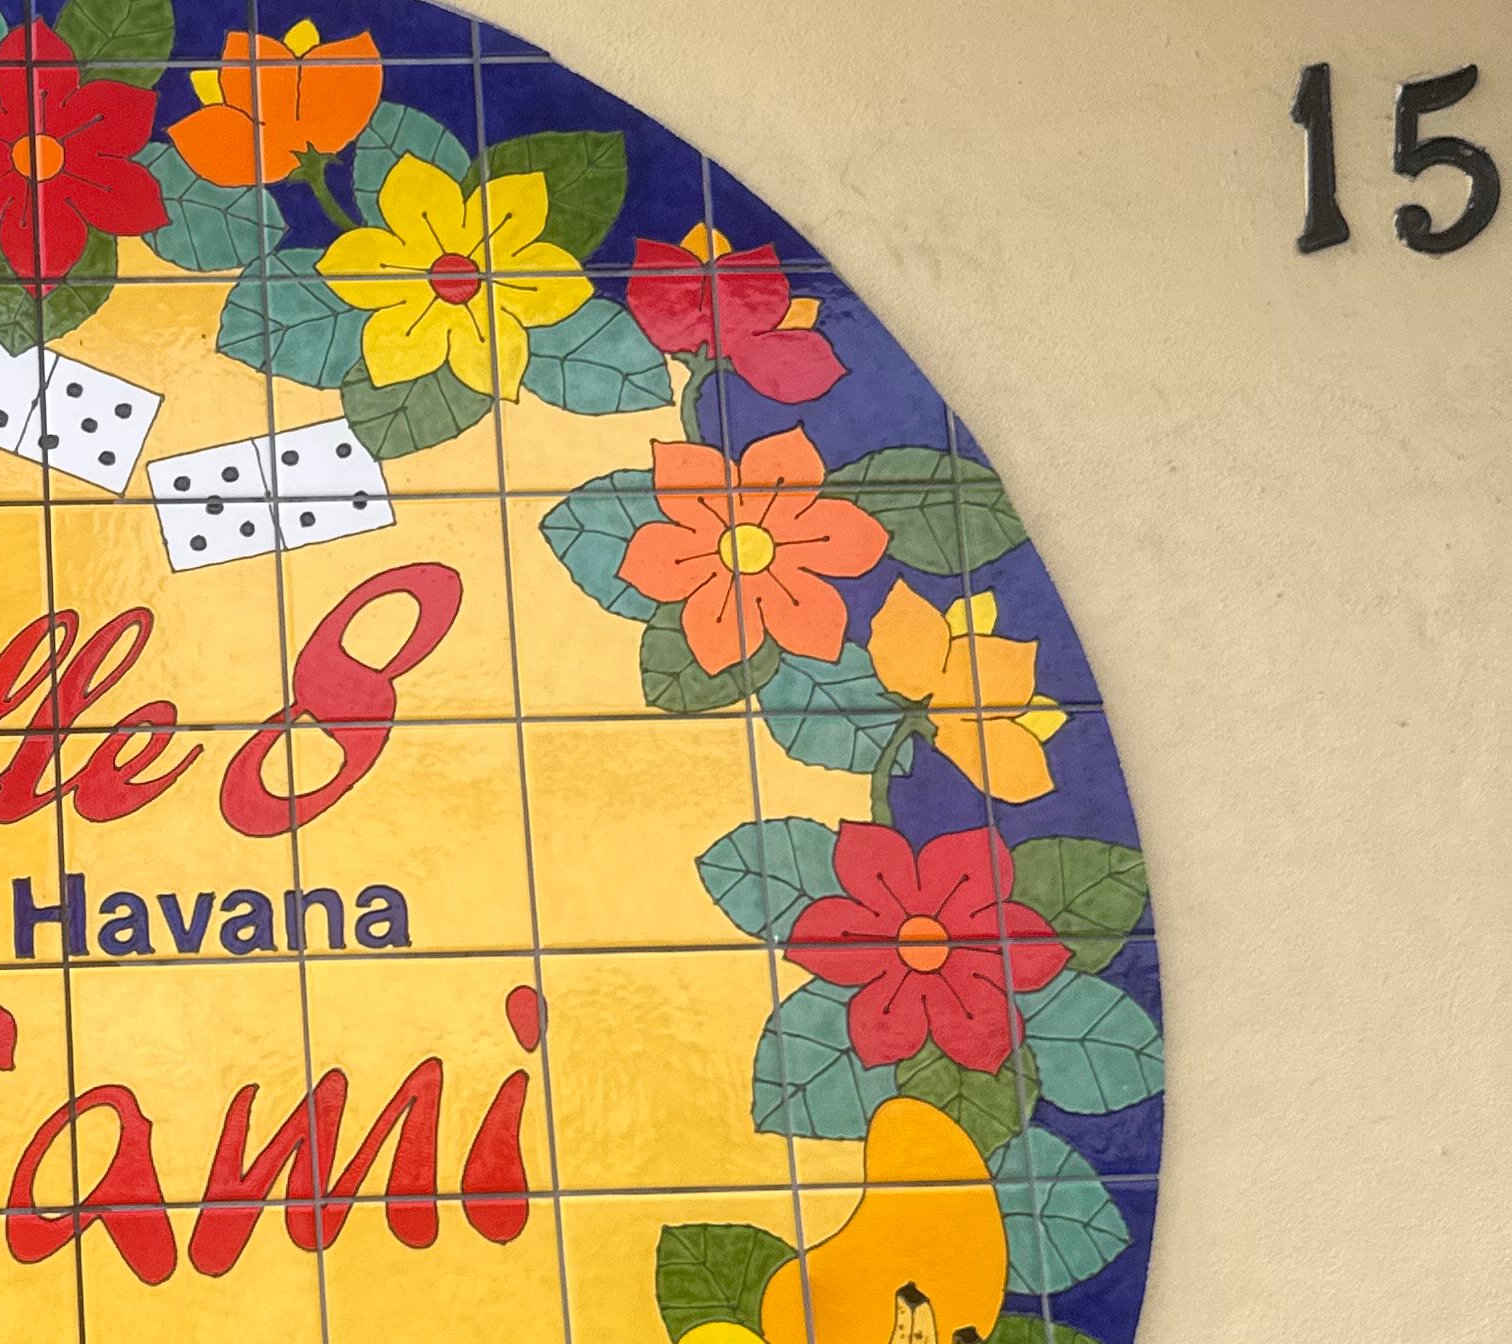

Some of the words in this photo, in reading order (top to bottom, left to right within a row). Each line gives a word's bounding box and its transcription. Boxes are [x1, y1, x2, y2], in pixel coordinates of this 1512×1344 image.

[1290, 62, 1500, 253] 15
[219, 561, 465, 838] 8
[12, 872, 412, 960] Havana
